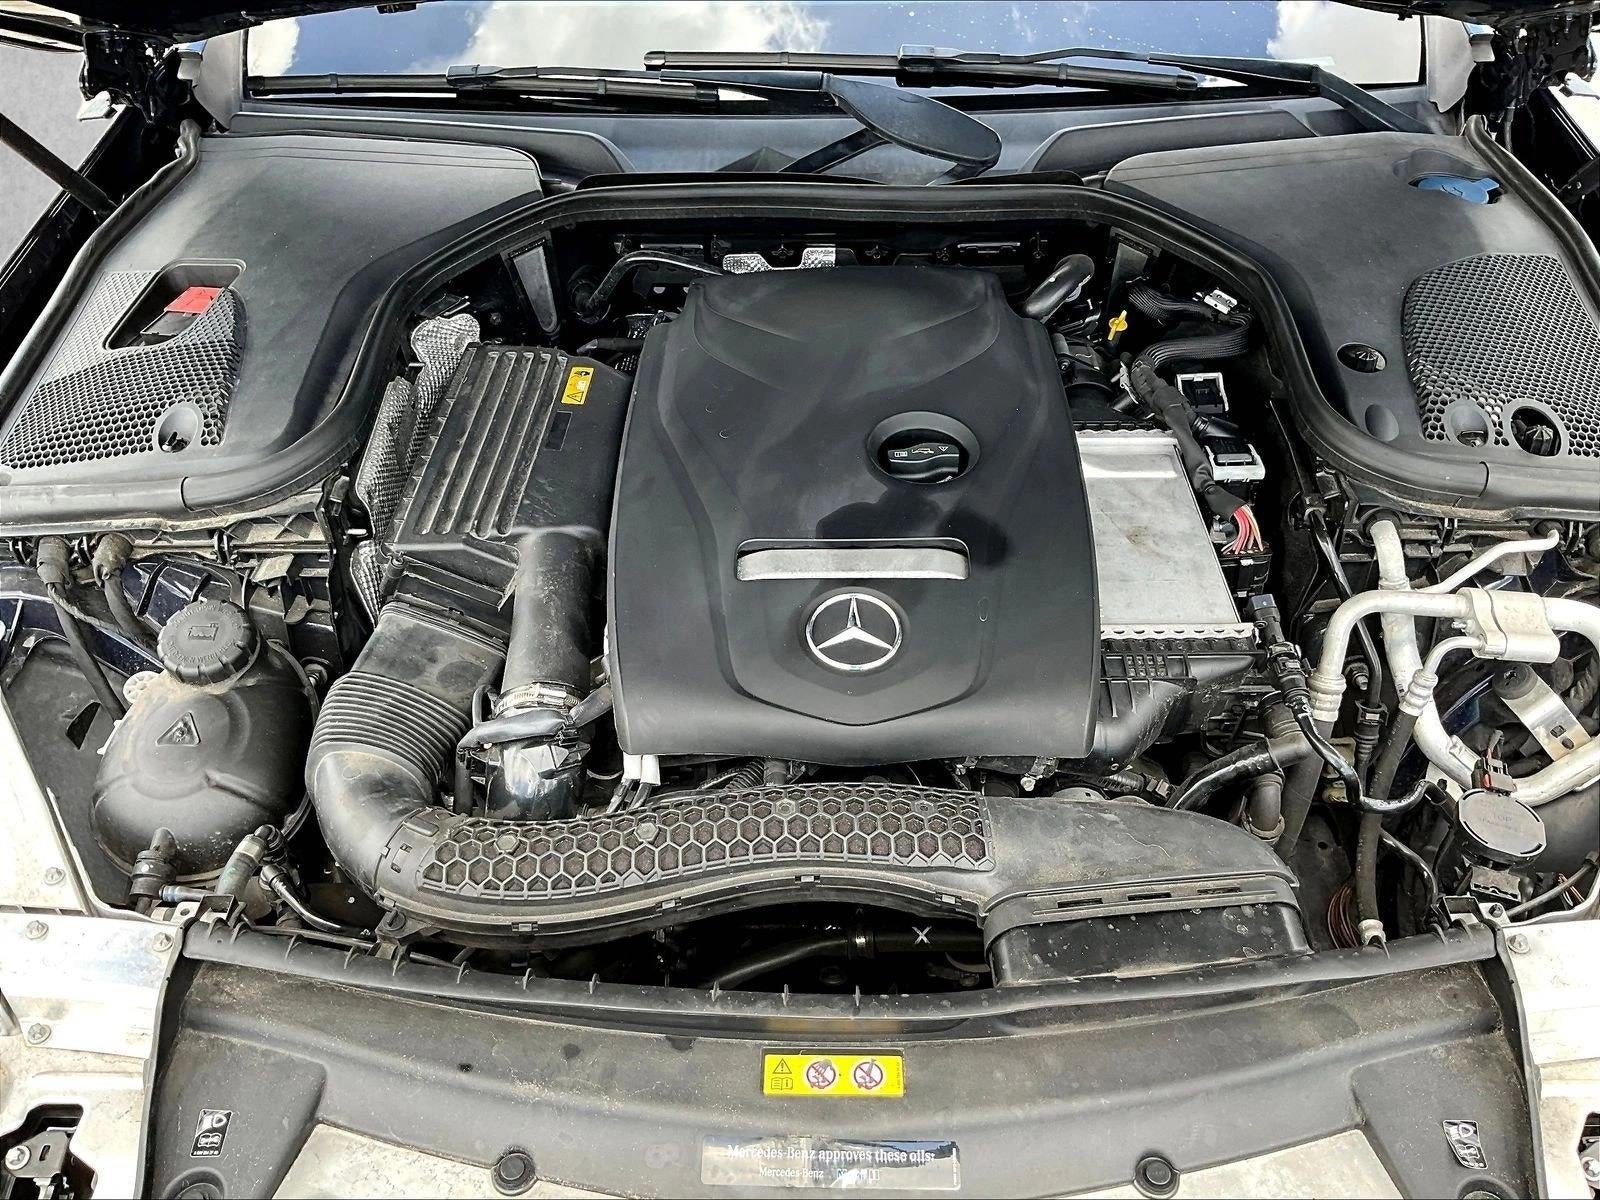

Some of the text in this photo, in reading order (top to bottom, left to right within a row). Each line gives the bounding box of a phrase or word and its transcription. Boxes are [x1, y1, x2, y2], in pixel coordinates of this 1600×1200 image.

[727, 1144, 936, 1164] Mercedes-Benz approves these oils:
[759, 1166, 825, 1178] Mercedes-Benz
